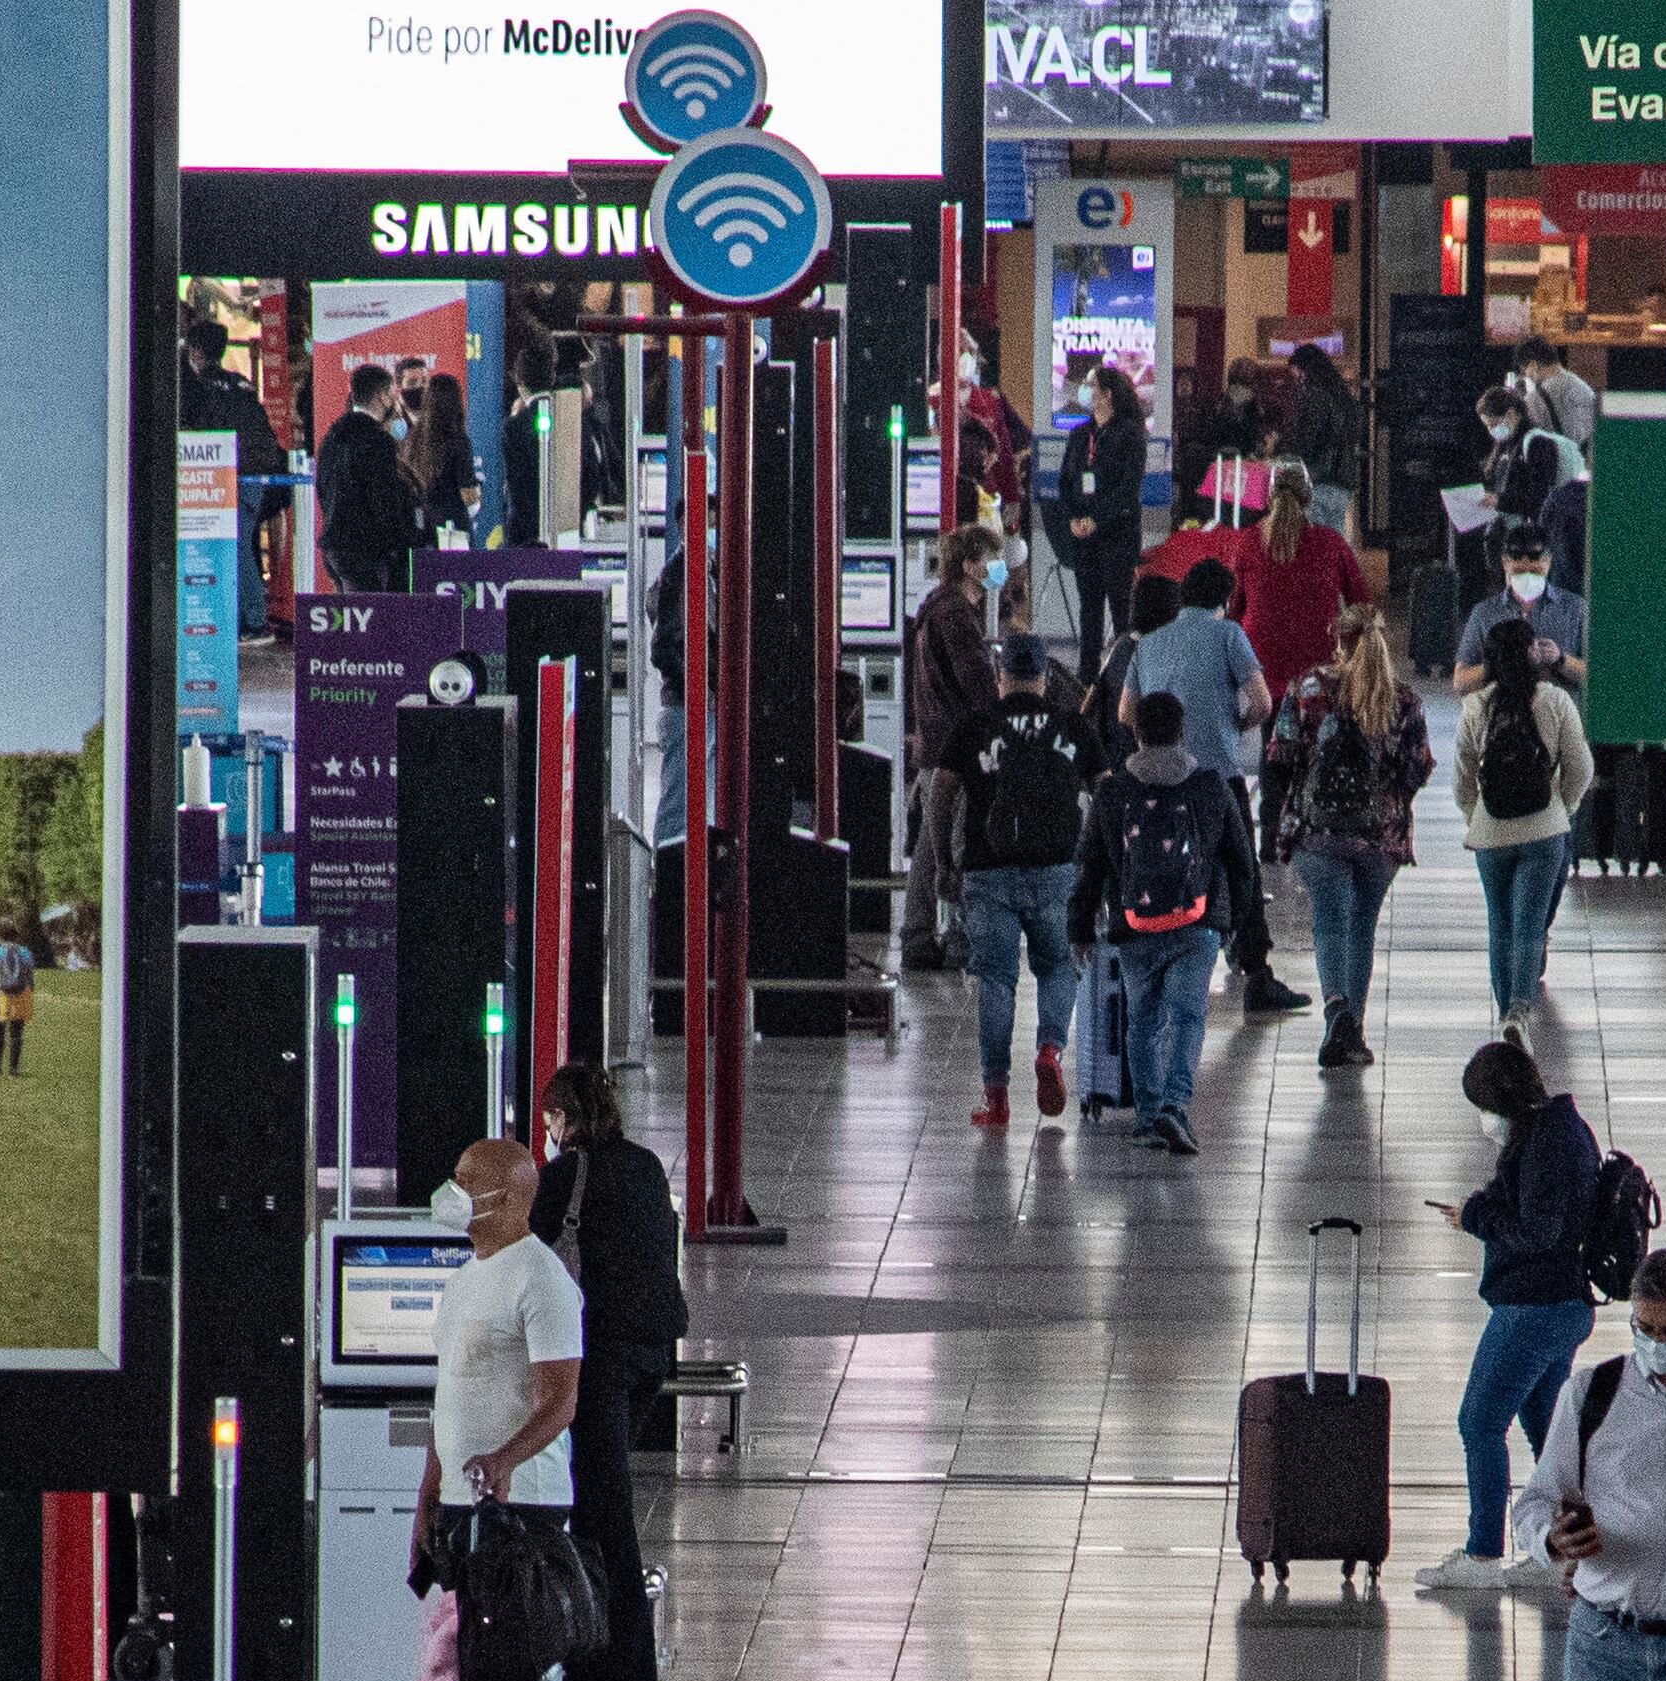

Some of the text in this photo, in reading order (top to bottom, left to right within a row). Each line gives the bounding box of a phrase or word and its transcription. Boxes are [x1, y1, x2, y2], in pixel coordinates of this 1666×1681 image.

[368, 16, 634, 63] Pide por McDeliv
[1580, 36, 1641, 70] Vía
[372, 202, 652, 257] SAMSUN
[309, 658, 404, 677] Preferente
[309, 686, 376, 705] Priority
[310, 815, 383, 829] Necesidades
